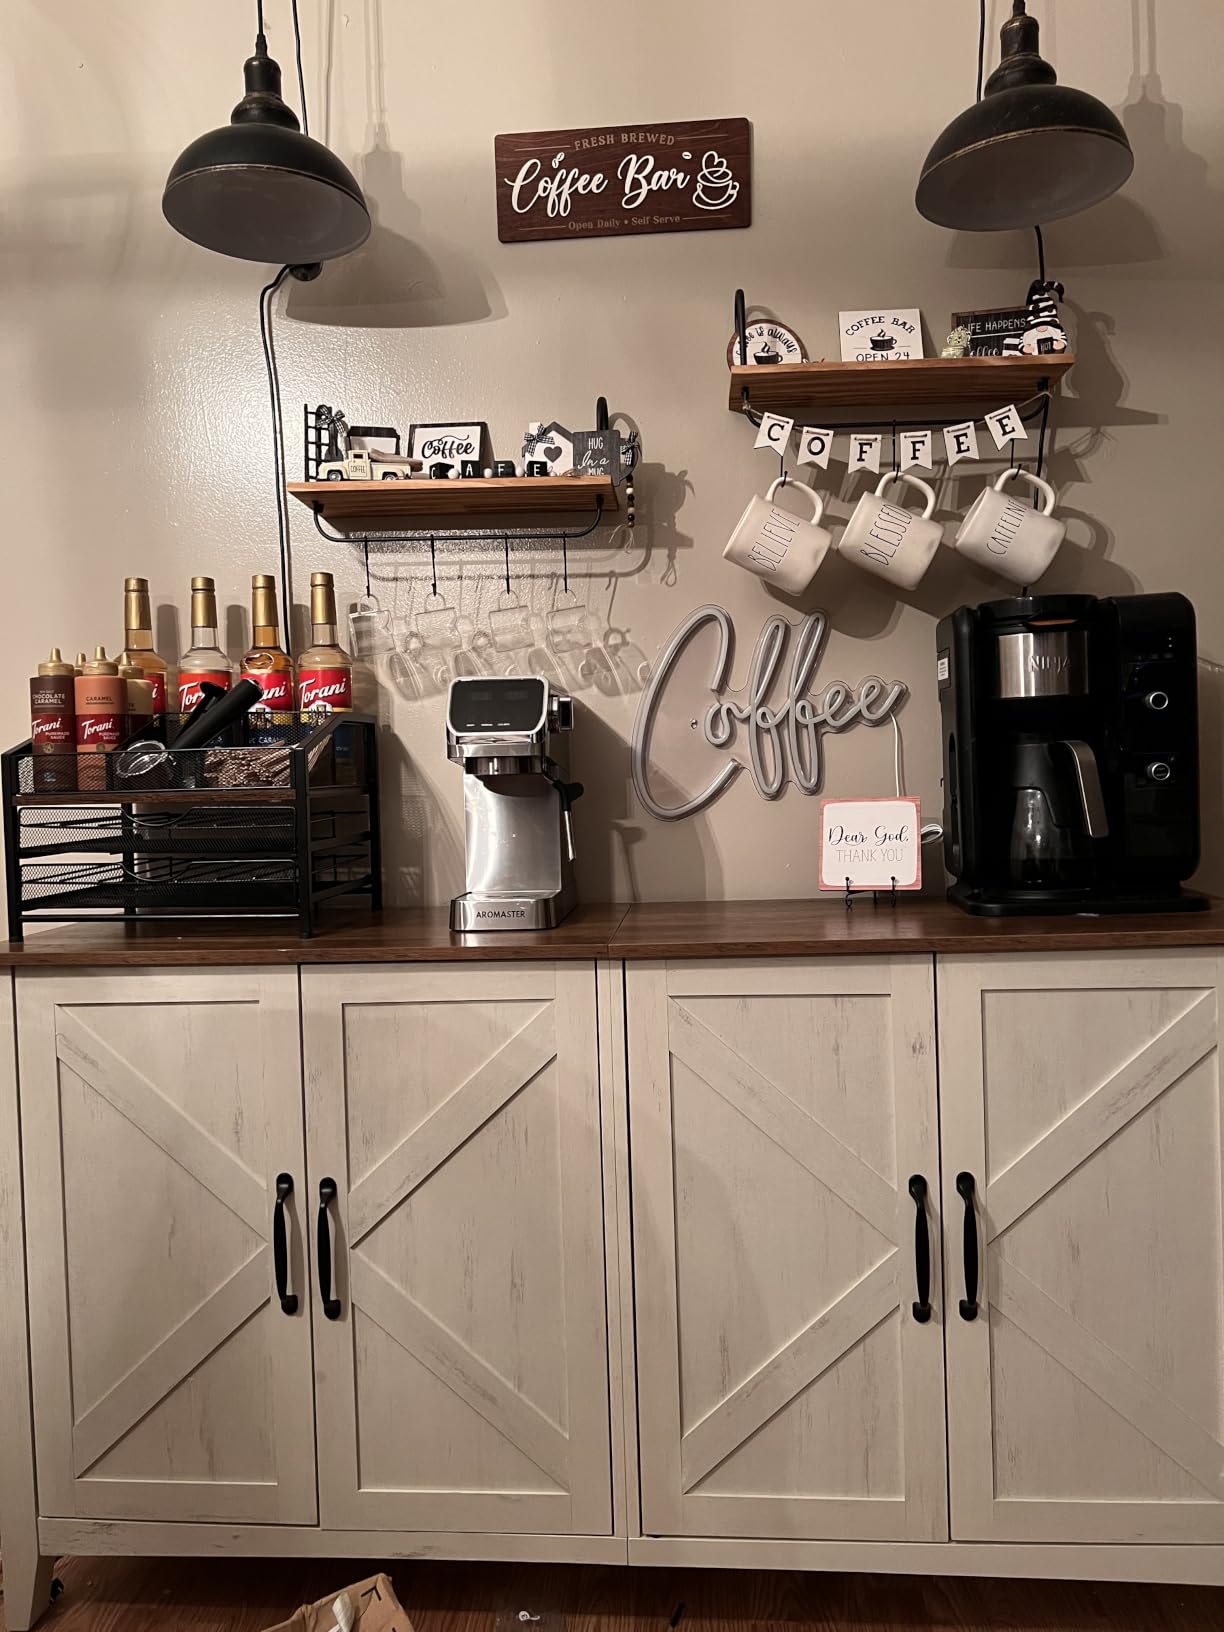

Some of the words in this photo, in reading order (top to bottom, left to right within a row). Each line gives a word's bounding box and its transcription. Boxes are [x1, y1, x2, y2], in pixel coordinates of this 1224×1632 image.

[574, 134, 615, 151] FRESH
[621, 132, 675, 146] BREWED
[504, 158, 608, 217] Coffee
[617, 154, 690, 209] Bar
[568, 220, 594, 231] Open
[597, 217, 622, 229] Daily
[631, 215, 650, 225] Self
[653, 214, 681, 225] Serve
[845, 315, 886, 336] COFFEE
[890, 317, 916, 334] BAR
[967, 321, 982, 333] IFE
[985, 318, 1026, 332] HAPPENS
[421, 434, 475, 459] Coffee
[588, 437, 604, 450] HUG
[350, 464, 366, 473] COFFEE
[860, 504, 912, 566] BLESSED
[986, 499, 1027, 555] CAFFEINE
[747, 508, 801, 572] BELIEVE
[299, 678, 346, 711] Torani
[633, 604, 903, 820] Coffee
[32, 718, 62, 739] Torani
[81, 719, 113, 740] Torani
[828, 825, 868, 846] Dear
[835, 848, 877, 863] THANK
[880, 848, 904, 862] YOU
[475, 910, 526, 919] AROMASTER
